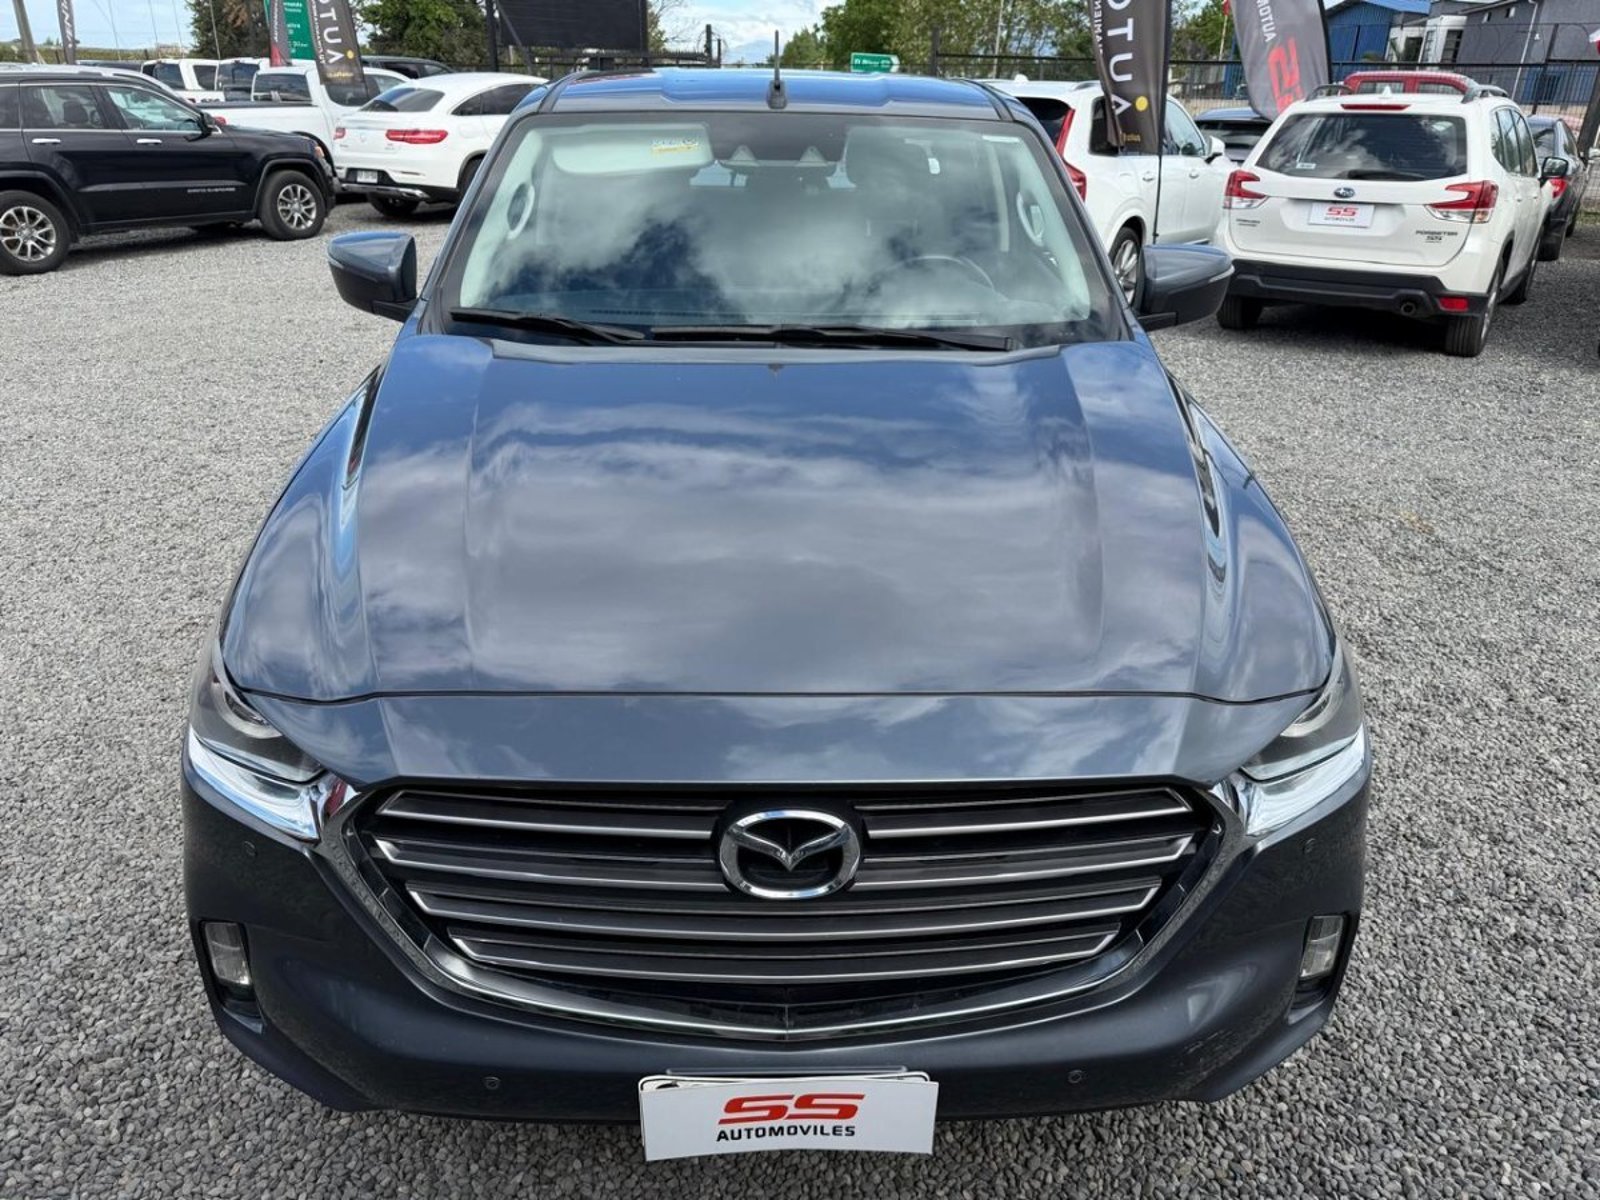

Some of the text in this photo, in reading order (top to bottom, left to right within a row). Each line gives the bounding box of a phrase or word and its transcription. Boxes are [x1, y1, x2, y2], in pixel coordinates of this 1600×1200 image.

[1326, 206, 1359, 217] SS
[718, 1094, 865, 1125] SS
[716, 1125, 856, 1142] AUTOMOVILES
